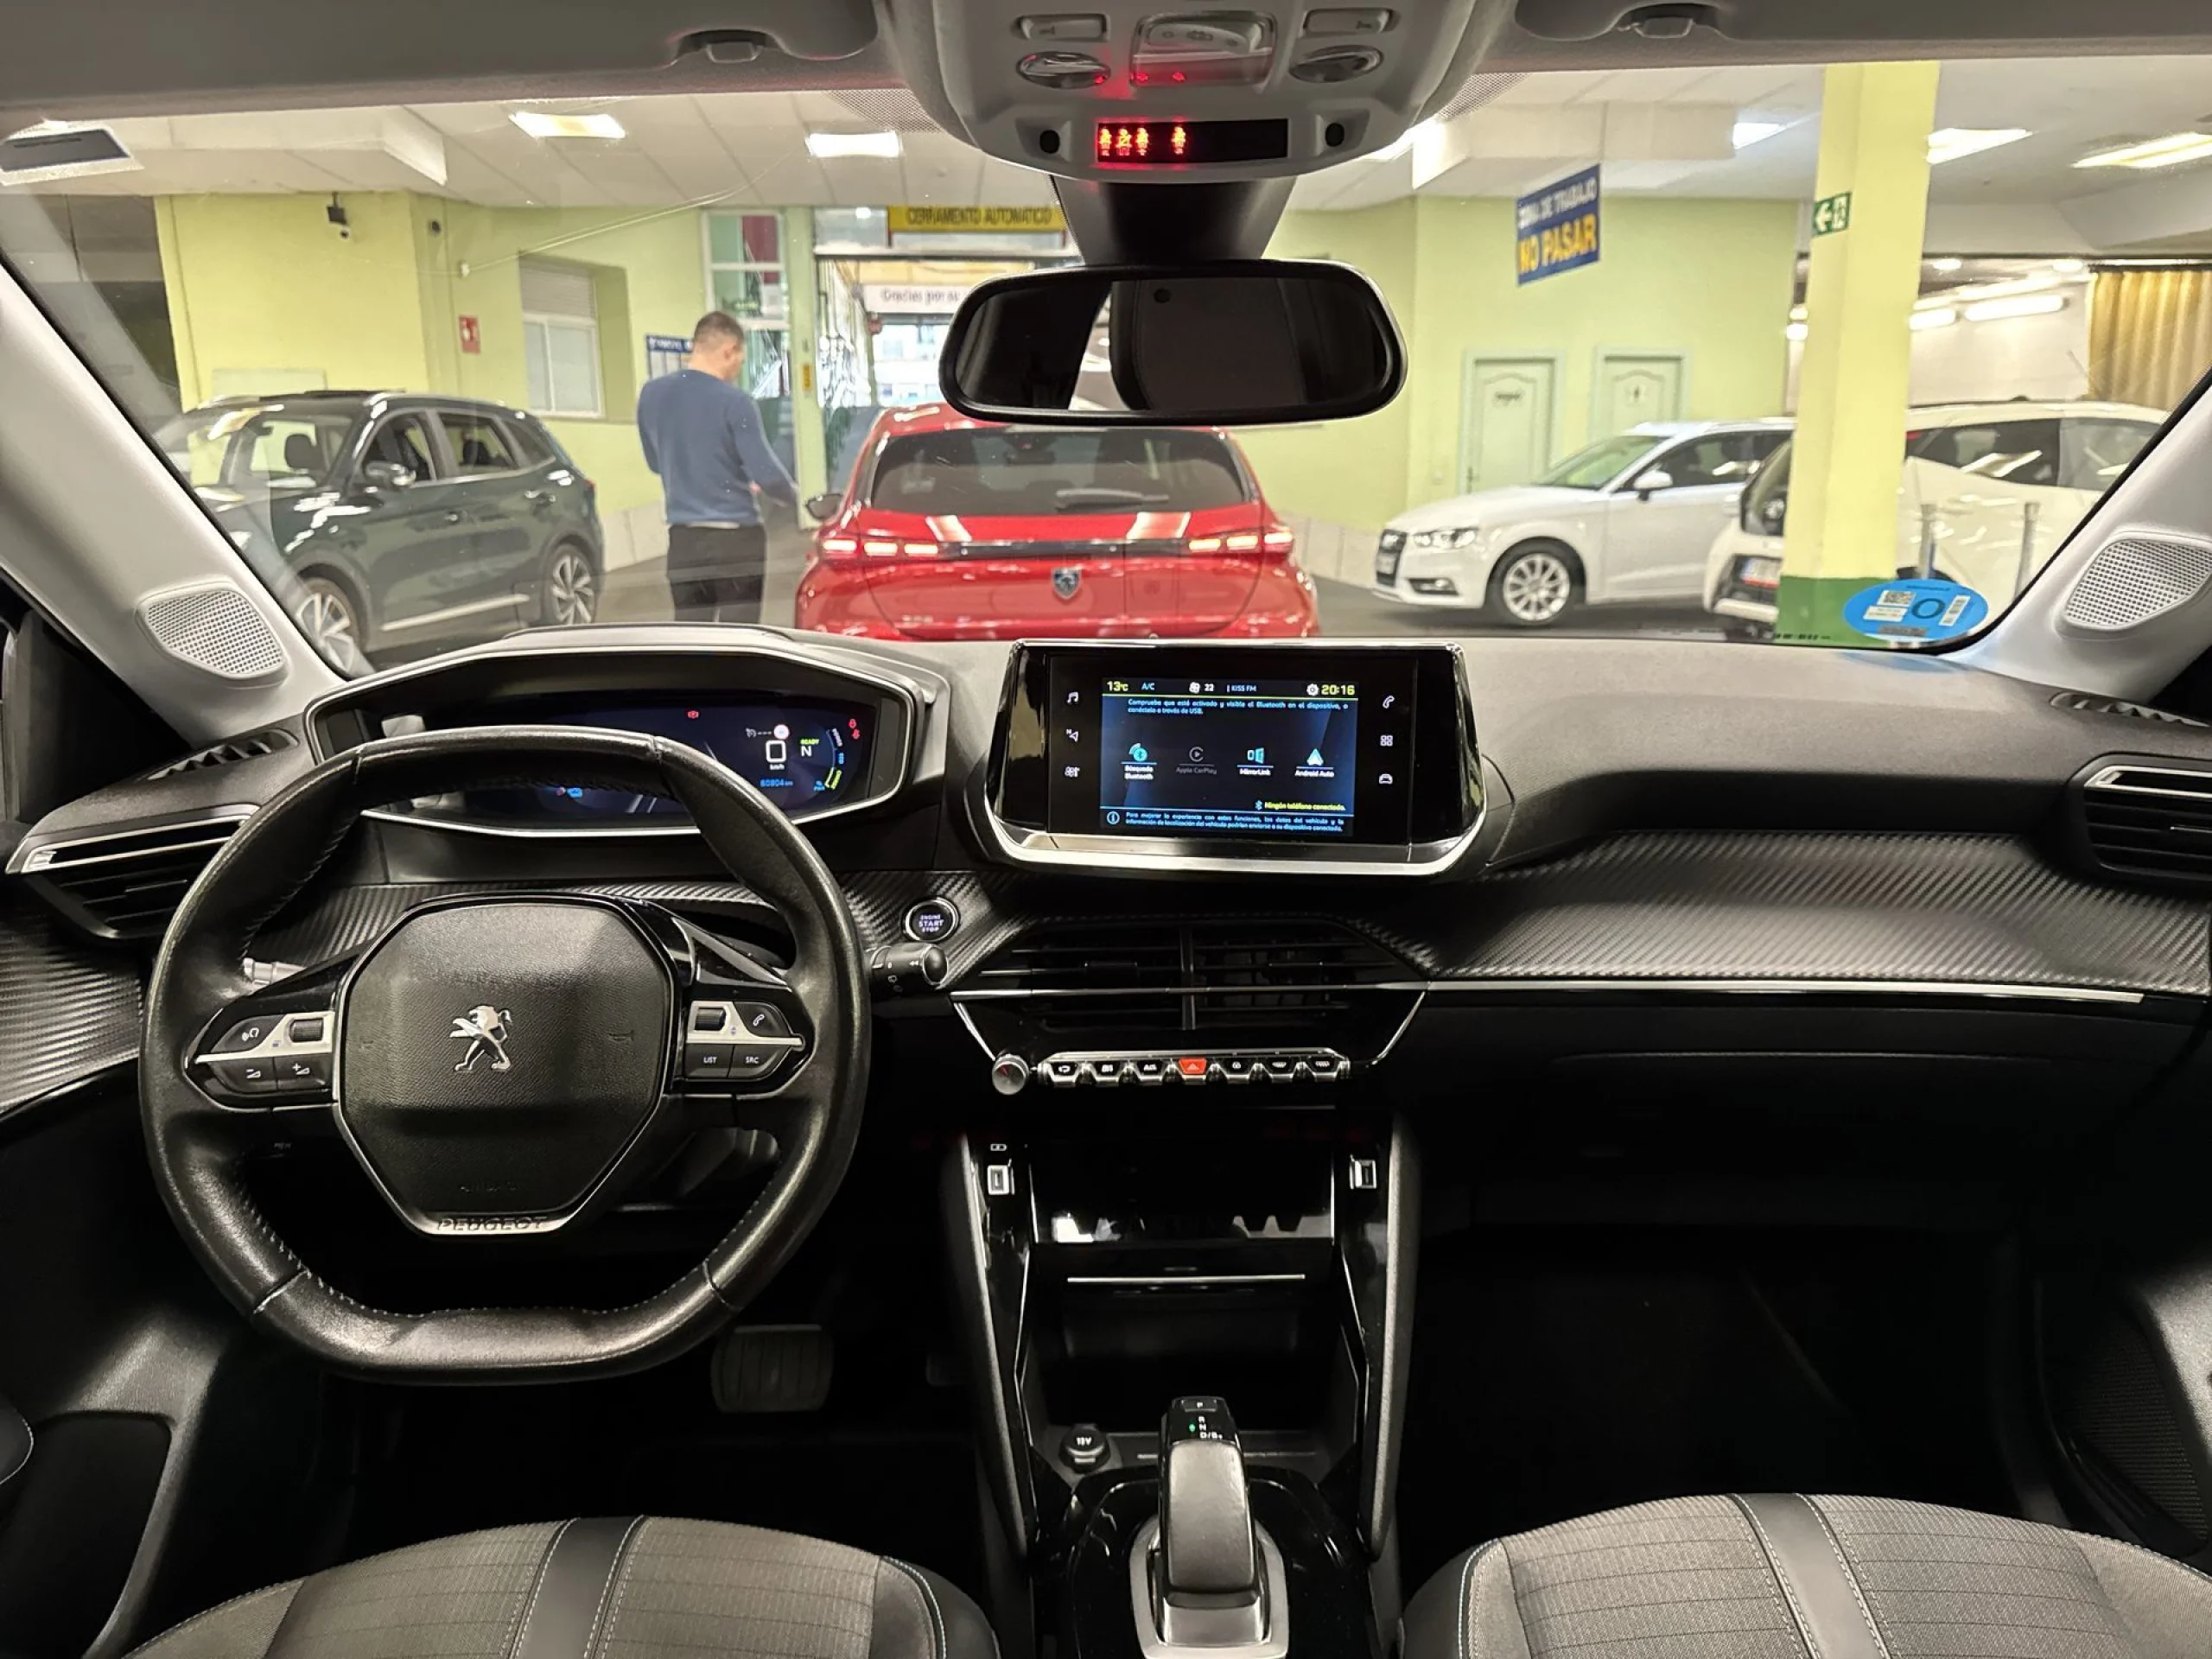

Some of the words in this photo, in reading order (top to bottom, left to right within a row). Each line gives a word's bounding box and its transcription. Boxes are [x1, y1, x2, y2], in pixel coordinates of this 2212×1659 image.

[1519, 234, 1540, 275] NO
[1541, 213, 1597, 266] PASAR
[1321, 683, 1355, 696] 20:16
[801, 745, 812, 757] N
[437, 1216, 547, 1231] PEUGEOT
